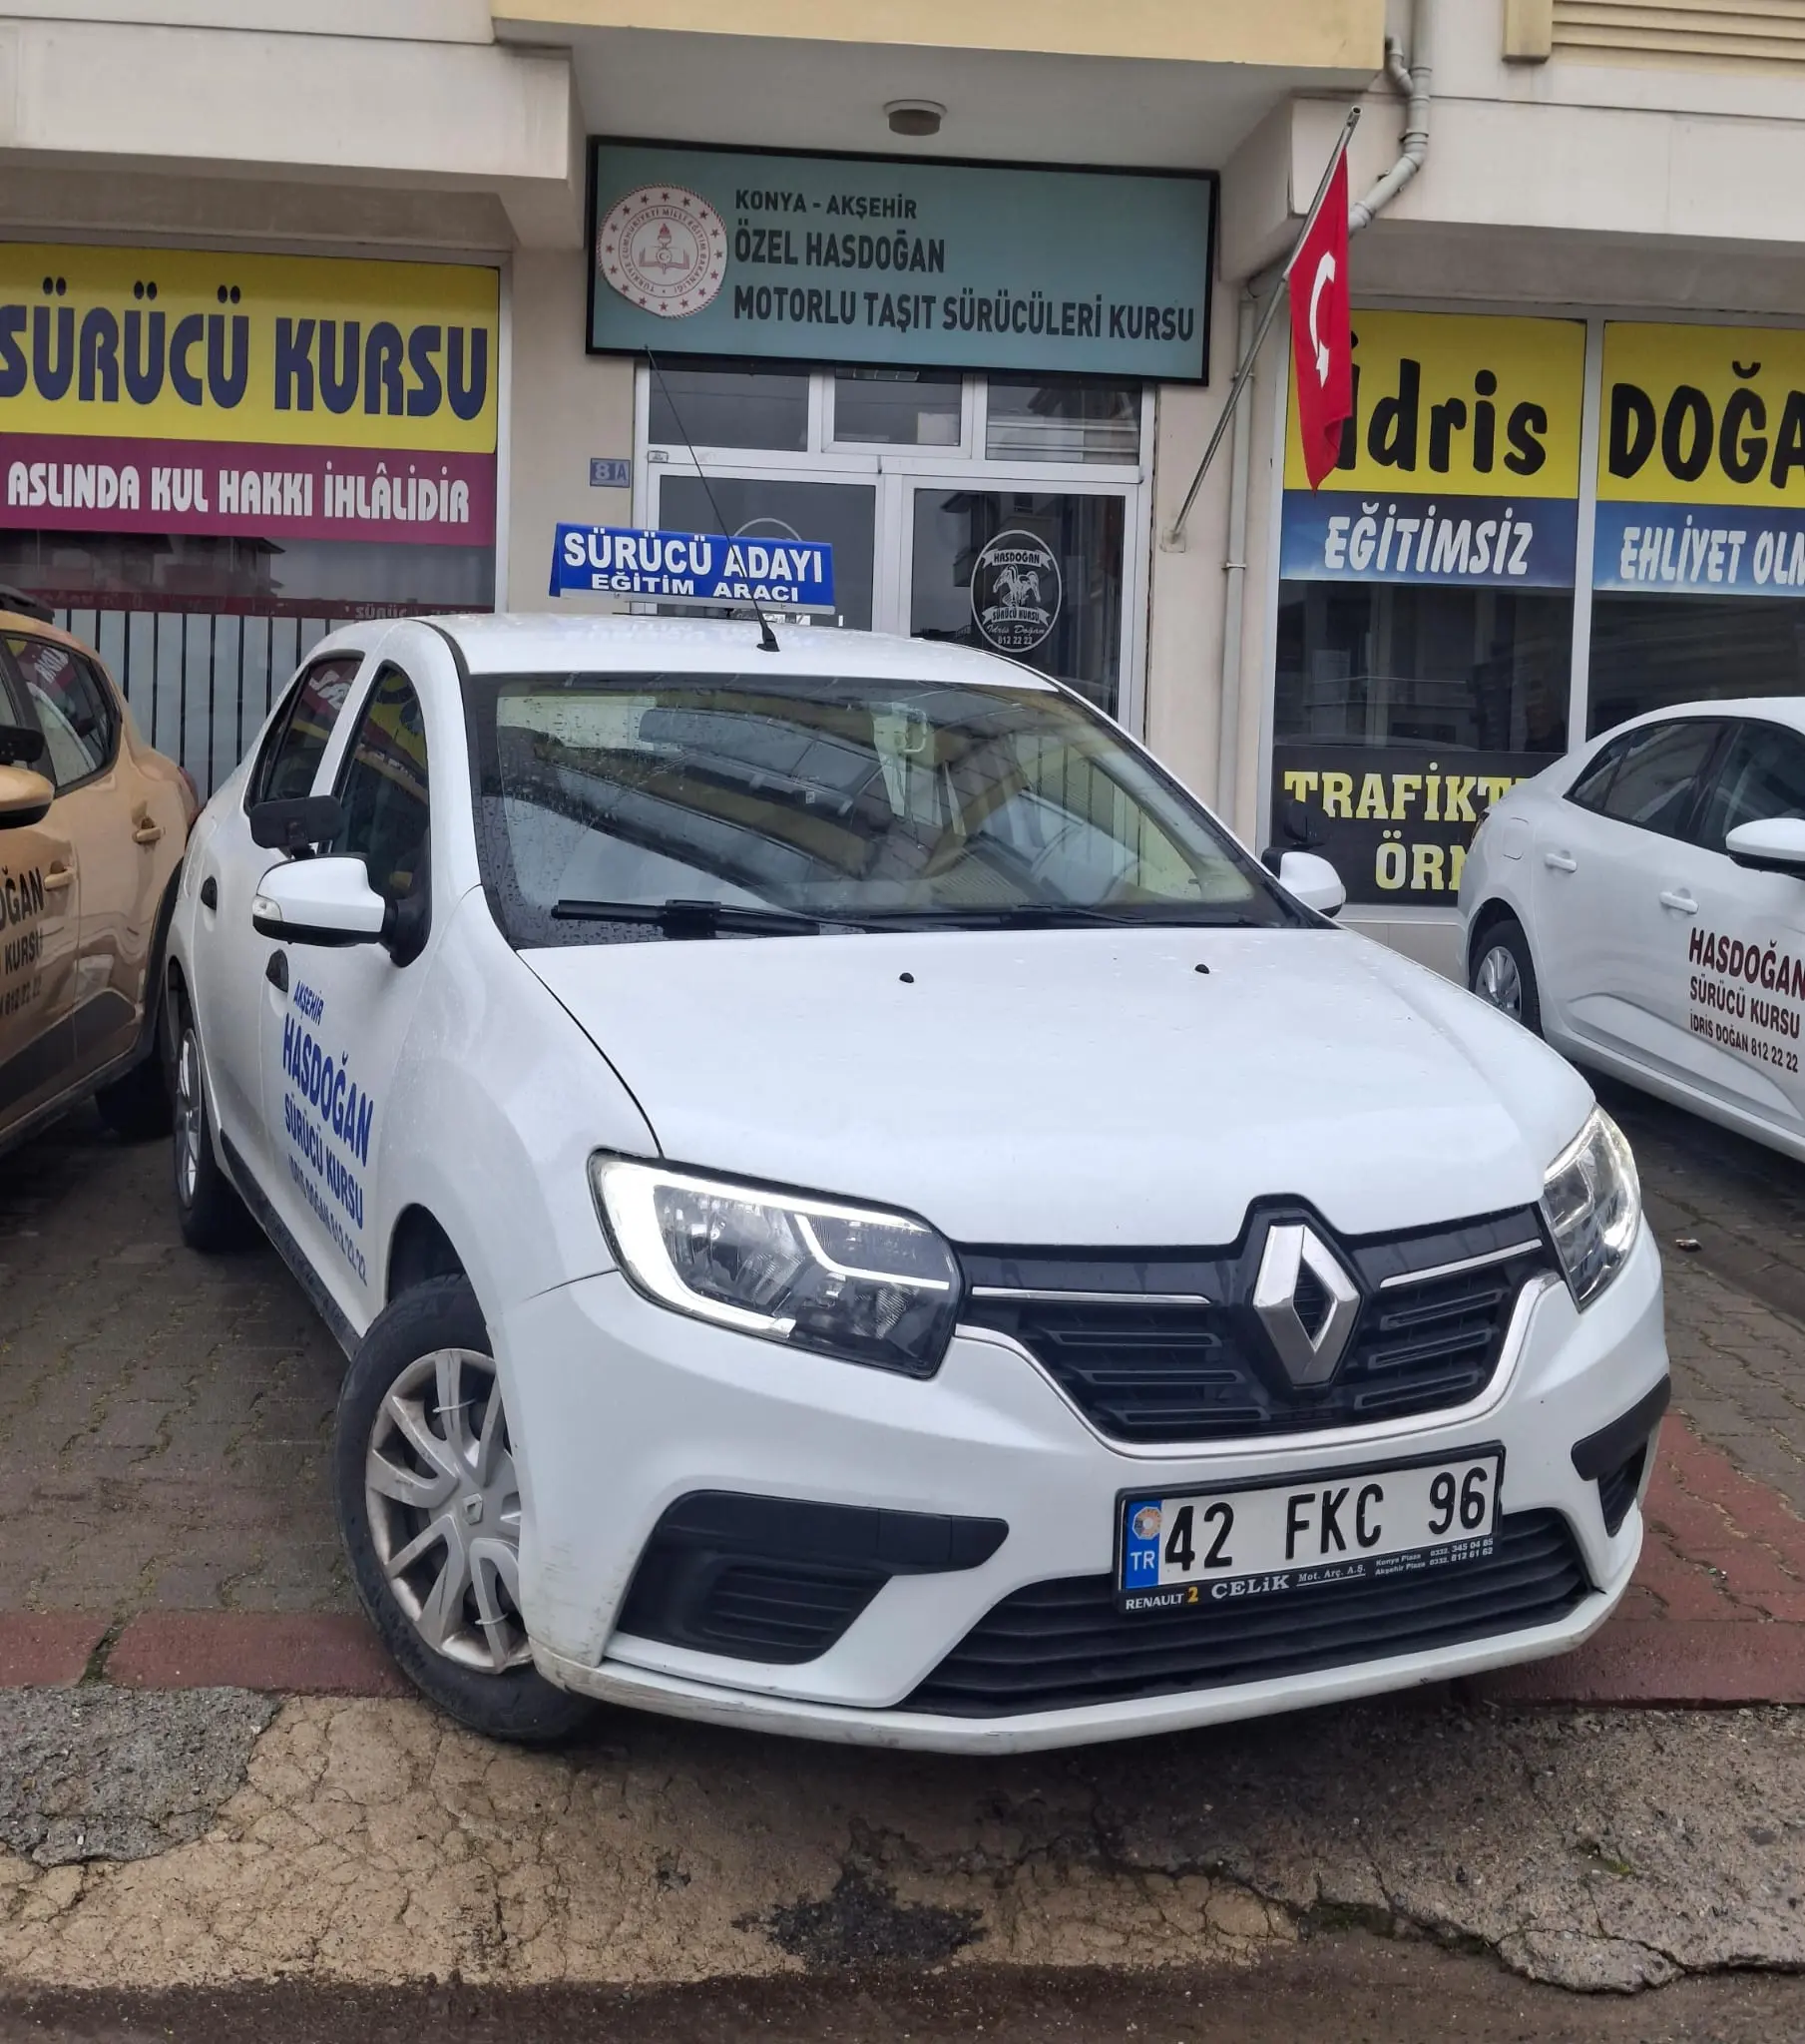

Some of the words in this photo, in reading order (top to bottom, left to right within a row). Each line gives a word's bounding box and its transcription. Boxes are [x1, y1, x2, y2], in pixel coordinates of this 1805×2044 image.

[735, 190, 806, 213] KONYA
[826, 193, 917, 220] AKŞEHİR
[734, 218, 798, 265] ÖZEL
[805, 229, 945, 272] HASDOĞAN
[734, 284, 856, 325] MOTORLU
[863, 291, 936, 333] TAŞIT
[942, 287, 1102, 337] SÜRÜCÜLERİ
[1109, 303, 1194, 342] KURSU
[0, 275, 248, 409] SÜRÜCÜ
[274, 316, 488, 421] KURSU
[8, 461, 140, 511] ASLINDA
[151, 466, 208, 513] KUL
[219, 469, 313, 518] HAKKI
[324, 460, 470, 524] İHLÂLİDİR
[564, 527, 711, 576] SÜRÜCÜ
[724, 544, 822, 583] ADAYI
[994, 551, 1040, 564] HASDOĞAN
[1323, 501, 1534, 576] EĞİTİMSİZ
[1620, 515, 1746, 583] EHLİYET
[592, 571, 694, 596] EĞİTİM
[713, 582, 798, 602] ARACI
[1013, 636, 1022, 645] 22
[1284, 762, 1533, 822] TRAFİKT
[1689, 927, 1805, 1001] HASDOĞAN
[293, 980, 324, 1026] AKŞEHİR
[1690, 974, 1745, 1018] SÜRÜCÜ
[1750, 998, 1800, 1039] KURSU
[1690, 1009, 1713, 1038] İDRİS
[1716, 1024, 1748, 1052] DOĞAN
[1752, 1038, 1768, 1061] 812
[1771, 1046, 1783, 1067] 22
[1786, 1052, 1798, 1073] 22
[283, 1012, 373, 1167] HASDOĞAN
[285, 1092, 323, 1177] SÜRÜCÜ
[326, 1146, 363, 1230] KURSU
[1165, 1502, 1234, 1571] 42
[1285, 1483, 1384, 1561] FKC
[1429, 1466, 1488, 1535] 96
[1129, 1550, 1155, 1571] TR
[1126, 1593, 1184, 1611] RENAULT
[1298, 1571, 1321, 1583] Mot.
